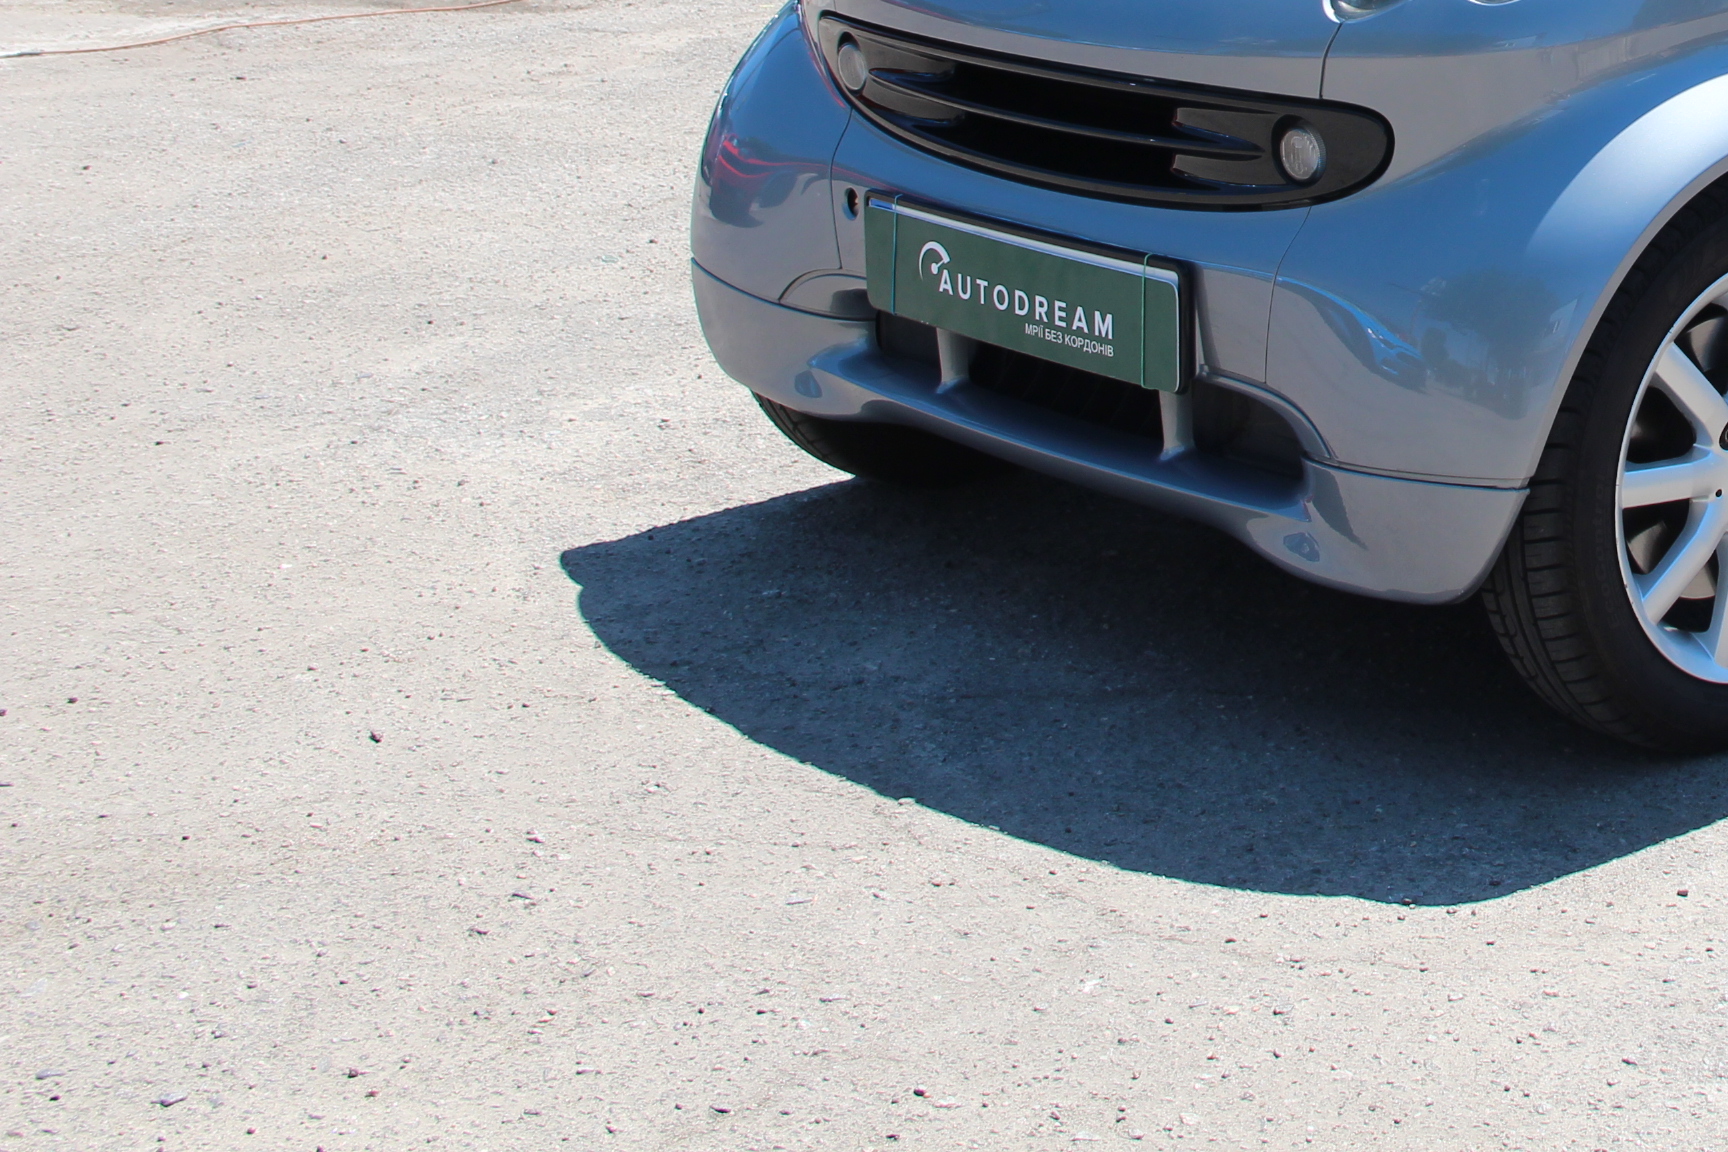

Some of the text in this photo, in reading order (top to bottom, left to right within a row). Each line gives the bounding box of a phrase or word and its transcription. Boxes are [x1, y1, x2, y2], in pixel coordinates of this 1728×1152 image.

[938, 268, 1114, 340] AUTODREAM
[1025, 322, 1115, 357] МРІЇ БЕЗ КОРДОНІВ
